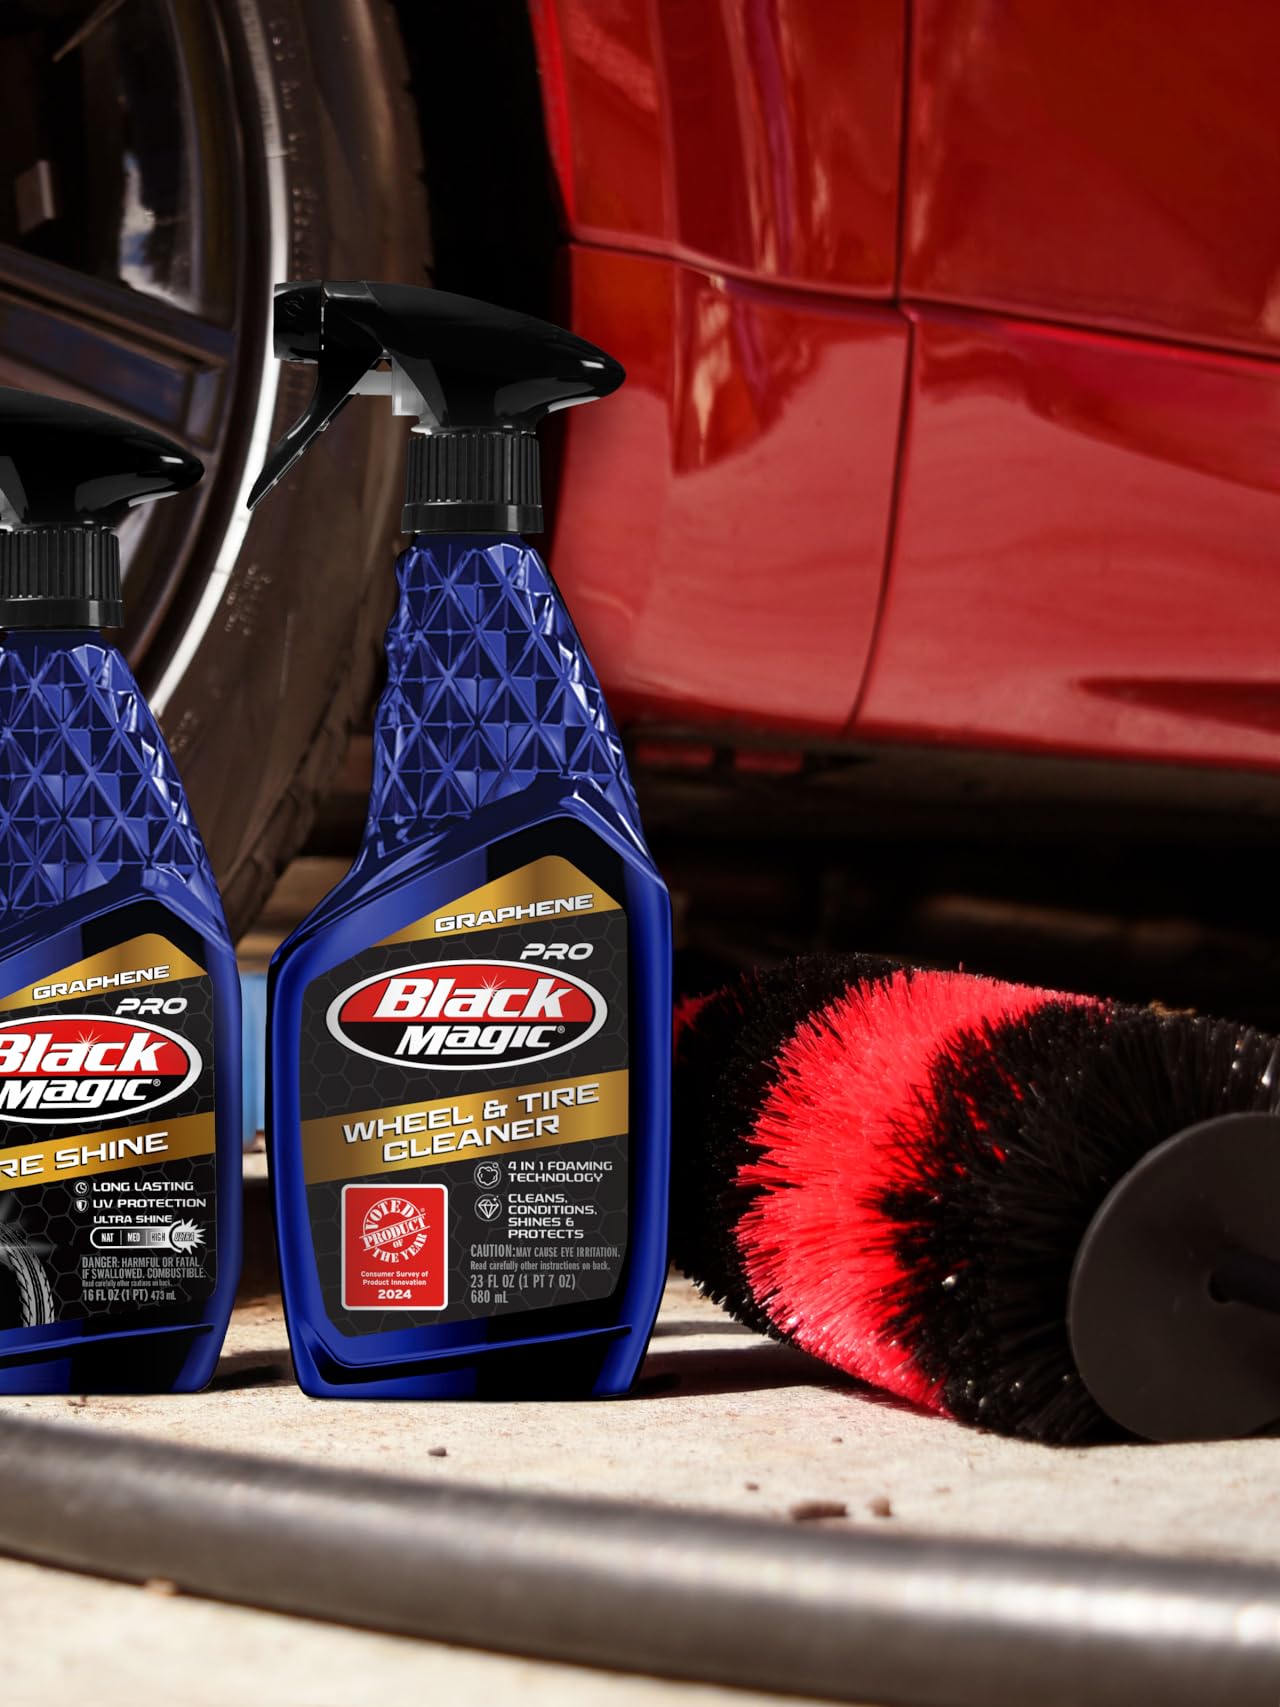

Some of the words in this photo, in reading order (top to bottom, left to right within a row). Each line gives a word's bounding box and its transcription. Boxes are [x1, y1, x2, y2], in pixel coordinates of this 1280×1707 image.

[434, 893, 594, 933] GRAPHENE
[520, 943, 594, 961] PRO
[33, 966, 170, 1000] GRAPHENE
[372, 977, 573, 1019] Black
[116, 998, 188, 1016] PRO
[343, 1106, 473, 1144] WHEEL
[483, 1100, 508, 1120] &
[517, 1082, 600, 1113] TIRE
[382, 1114, 560, 1164] CLEANER
[55, 1132, 169, 1170] SHINE
[508, 1161, 517, 1171] 4
[520, 1161, 535, 1171] IN
[539, 1161, 544, 1171] 1
[547, 1161, 613, 1171] FOAMING
[508, 1172, 603, 1183] TECHNOLOGY
[92, 1182, 130, 1192] LONG
[134, 1181, 194, 1191] LASTING
[92, 1199, 113, 1209] UV
[117, 1198, 207, 1208] PROTECTION
[93, 1215, 132, 1224] ULTRA
[136, 1214, 172, 1224] SHINE
[365, 1199, 415, 1230] VOTED
[508, 1217, 561, 1228] SHINES
[101, 1232, 114, 1243] NAT
[127, 1232, 141, 1243] MED
[150, 1232, 166, 1242] HIGH
[174, 1232, 195, 1242] ULTRA
[362, 1216, 426, 1250] PRODUCT
[508, 1229, 584, 1239] PROTECTS
[372, 1247, 399, 1263] THE
[400, 1233, 428, 1260] YEAR
[392, 1238, 404, 1249] OF
[534, 1246, 558, 1258] CAUSE
[560, 1246, 574, 1258] EYE
[576, 1246, 621, 1258] IRRITATION.
[82, 1256, 120, 1268] DANGER:
[122, 1257, 160, 1267] HARMFUL
[162, 1257, 174, 1267] OR
[175, 1256, 200, 1267] FATAL
[470, 1261, 487, 1270] Read
[489, 1261, 519, 1272] carefully
[520, 1261, 538, 1270] other
[540, 1261, 580, 1270] instructions
[582, 1262, 590, 1270] on
[592, 1261, 611, 1270] back.
[82, 1268, 90, 1279] IF
[91, 1268, 145, 1279] SWALLOWED.
[147, 1268, 206, 1279] COMBUSTIBLE.
[361, 1270, 394, 1278] Consumer
[396, 1270, 420, 1279] Survey
[470, 1274, 484, 1288] 23
[488, 1274, 499, 1288] FL
[502, 1274, 515, 1288] OZ
[519, 1273, 529, 1291] (1
[533, 1274, 545, 1288] PT
[548, 1274, 555, 1288] 7
[558, 1273, 576, 1291] OZ)
[83, 1289, 94, 1301] 16
[96, 1289, 107, 1301] FL
[108, 1289, 119, 1301] OZ
[121, 1288, 130, 1302] (1
[132, 1288, 148, 1302] PT)
[150, 1290, 165, 1301] 473
[377, 1289, 412, 1300] 2024
[471, 1290, 491, 1304] 680
[494, 1290, 509, 1304] mL
